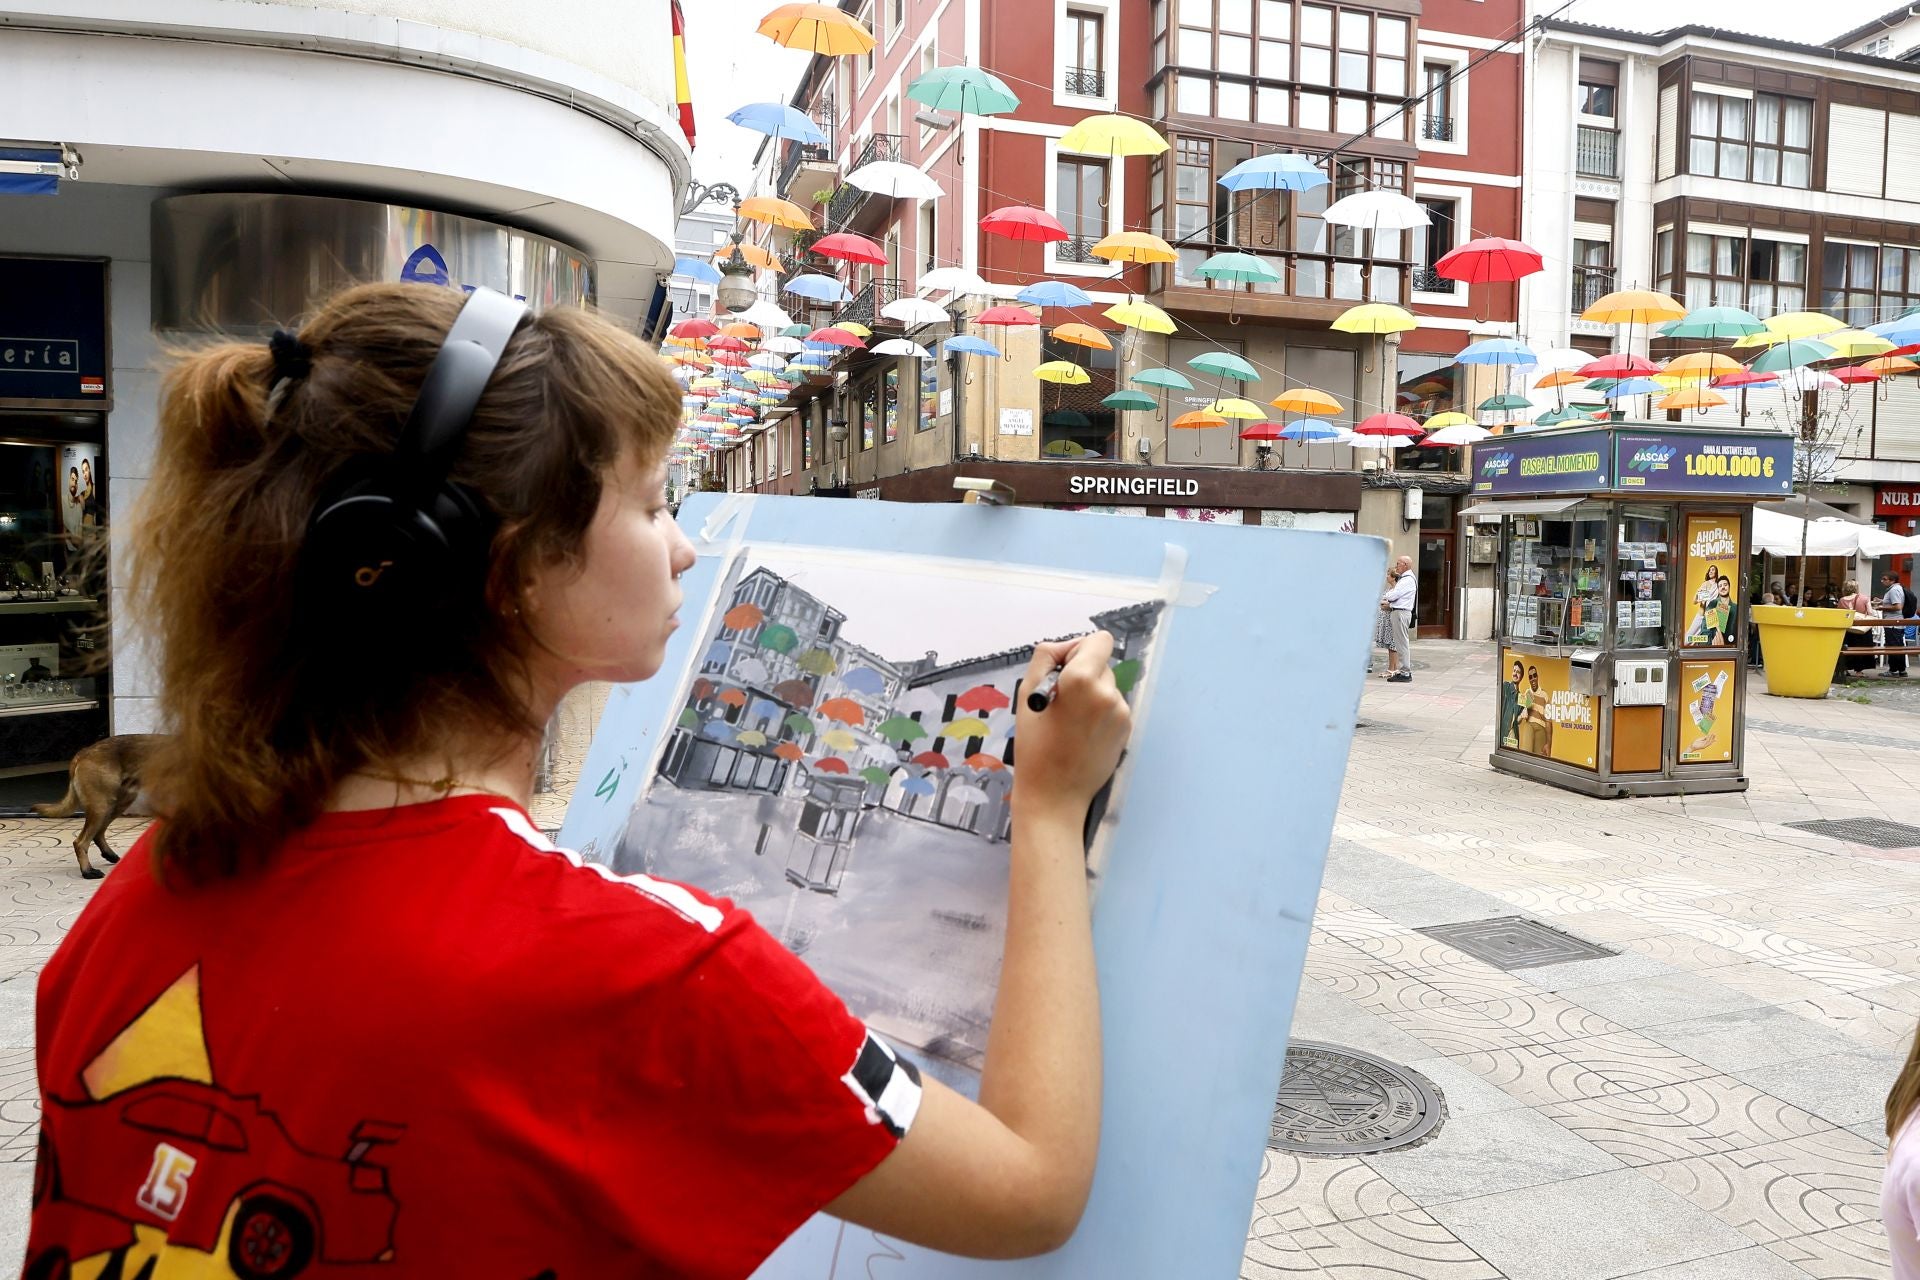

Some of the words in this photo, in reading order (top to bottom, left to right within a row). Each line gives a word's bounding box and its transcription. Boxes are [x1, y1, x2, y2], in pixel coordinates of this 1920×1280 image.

[3, 344, 72, 366] ería
[1634, 452, 1669, 462] RASCAS
[1703, 445, 1716, 454] GANA
[1716, 445, 1722, 454] AL
[1484, 458, 1510, 469] RASCAS
[1520, 457, 1546, 476] RASCA
[1546, 456, 1557, 473] EL
[1557, 452, 1599, 473] MOMENTO
[1685, 454, 1761, 477] 1.000.000
[1763, 456, 1775, 478] €
[1070, 476, 1199, 496] SPRINGFIELD
[1882, 491, 1910, 506] NUR
[1696, 527, 1728, 544] AHORA
[1690, 539, 1735, 558] SIEMPRE
[1544, 703, 1592, 724] SIEMPRE
[1573, 723, 1594, 731] JUGADO
[1340, 1123, 1391, 1143] MOPU
[138, 1144, 195, 1219] 15
